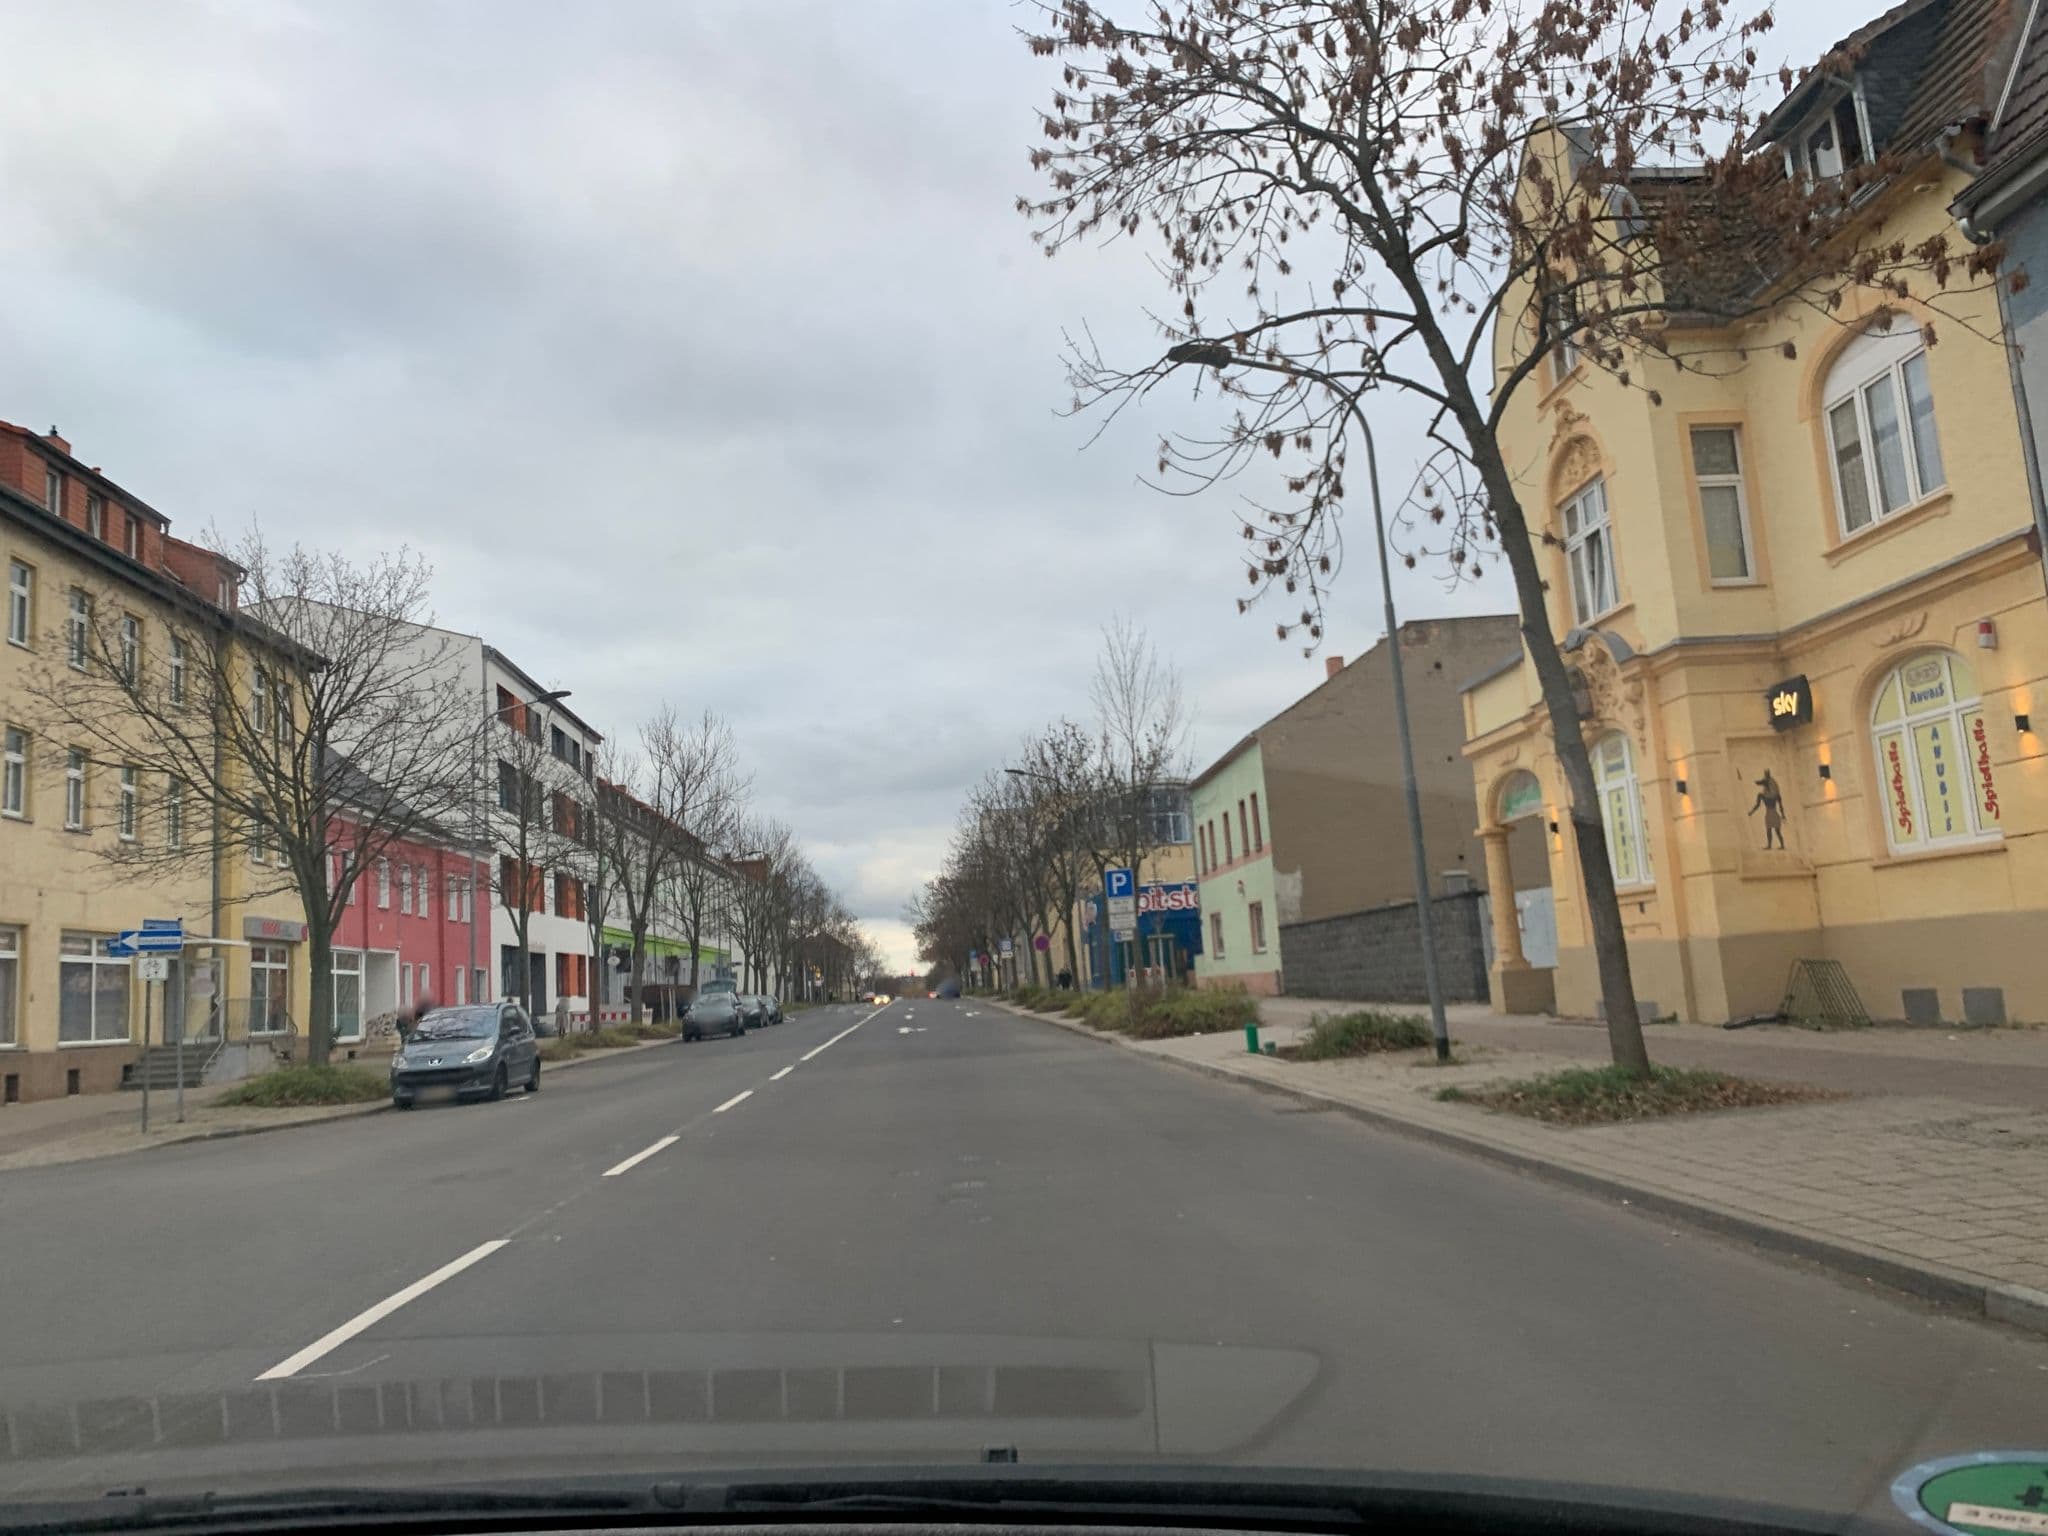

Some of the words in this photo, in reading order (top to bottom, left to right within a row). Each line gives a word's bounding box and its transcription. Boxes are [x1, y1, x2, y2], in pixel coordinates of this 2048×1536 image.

[1773, 691, 1797, 716] sky
[1931, 726, 1952, 832] ANUBIS
[1973, 718, 2000, 820] Spielhalle
[1111, 872, 1127, 895] P
